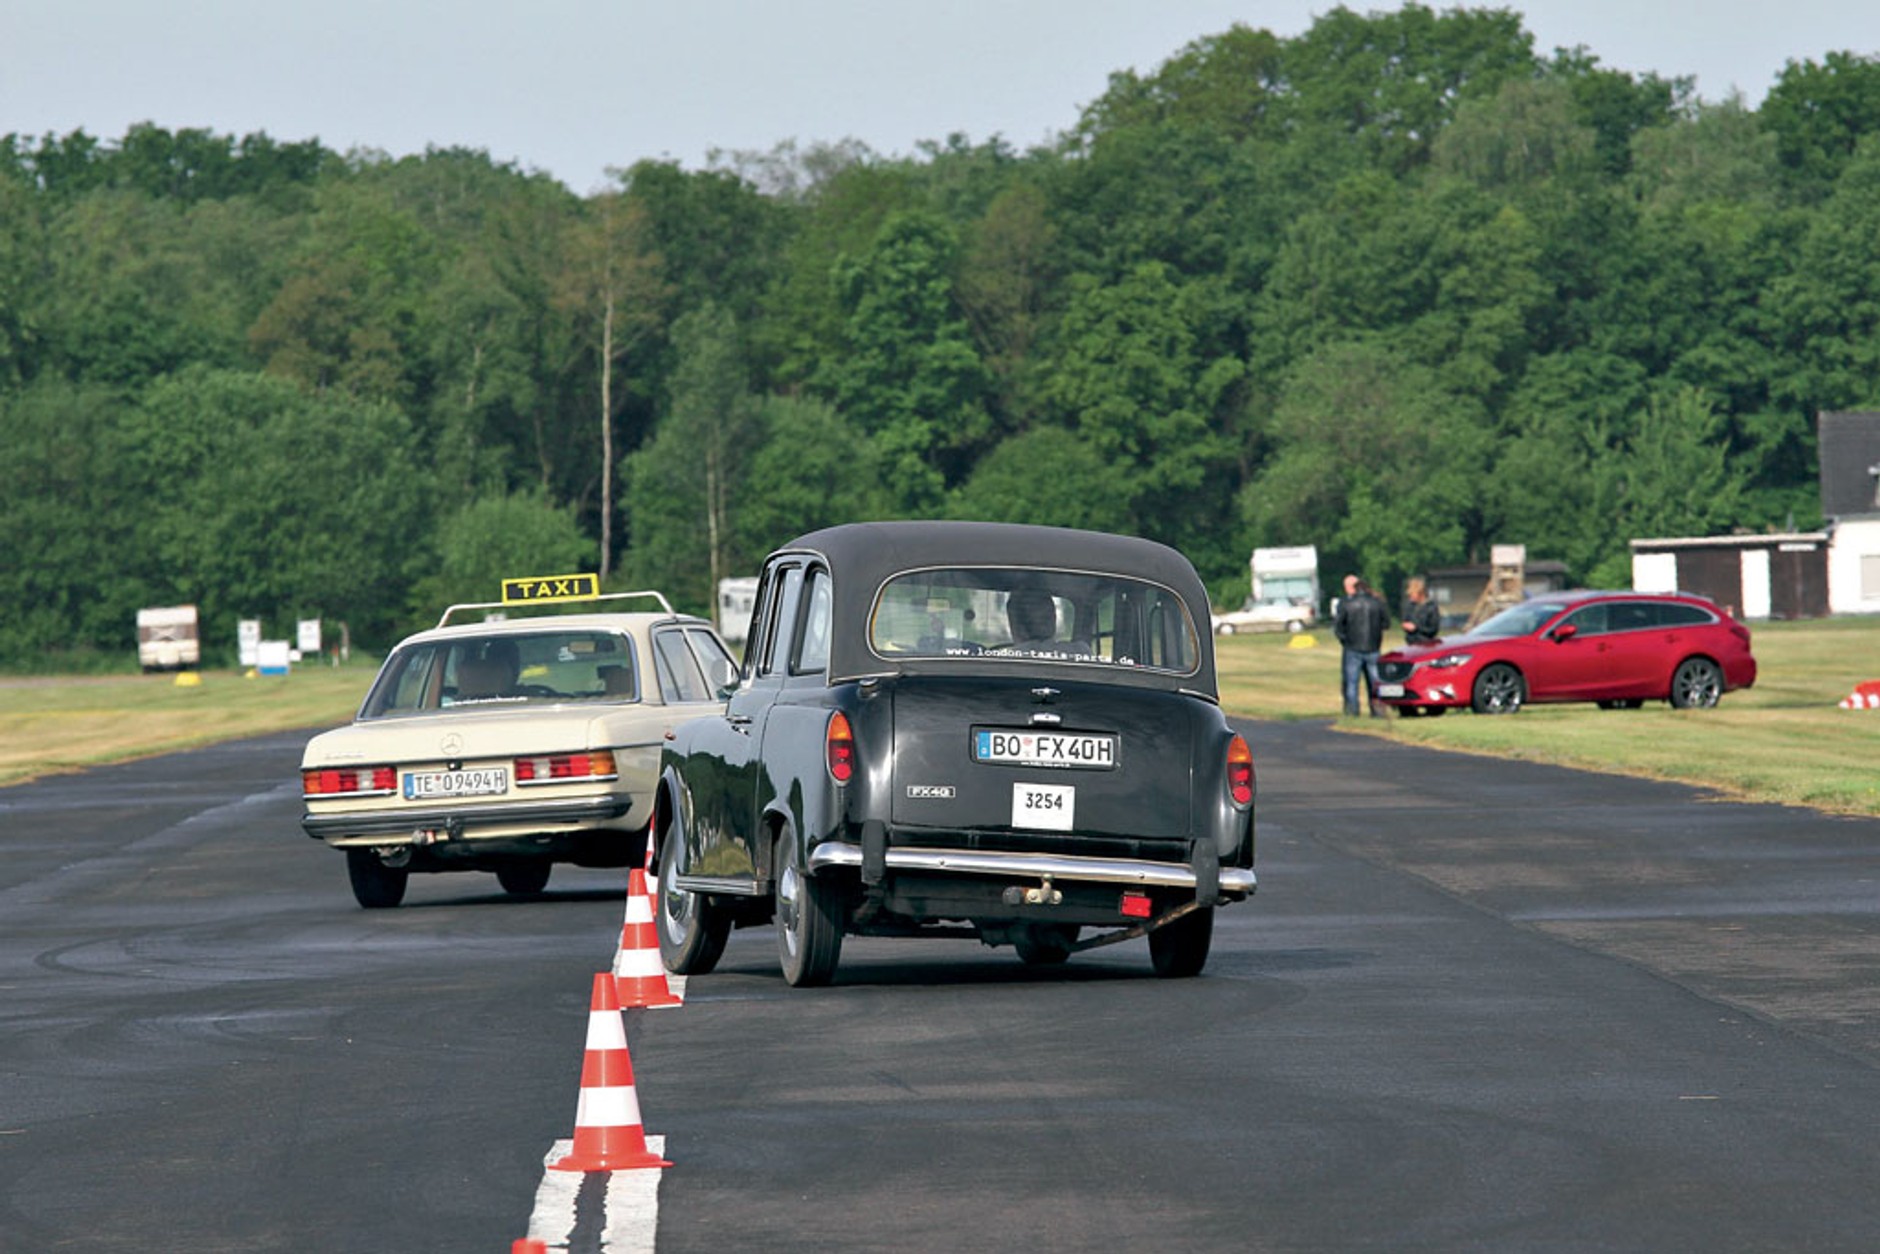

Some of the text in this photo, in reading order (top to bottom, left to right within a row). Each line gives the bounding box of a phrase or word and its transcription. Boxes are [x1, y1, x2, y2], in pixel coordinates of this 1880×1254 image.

[517, 580, 580, 598] TAXI
[992, 735, 1021, 756] BO
[415, 776, 432, 793] TE
[1025, 792, 1063, 810] 3254
